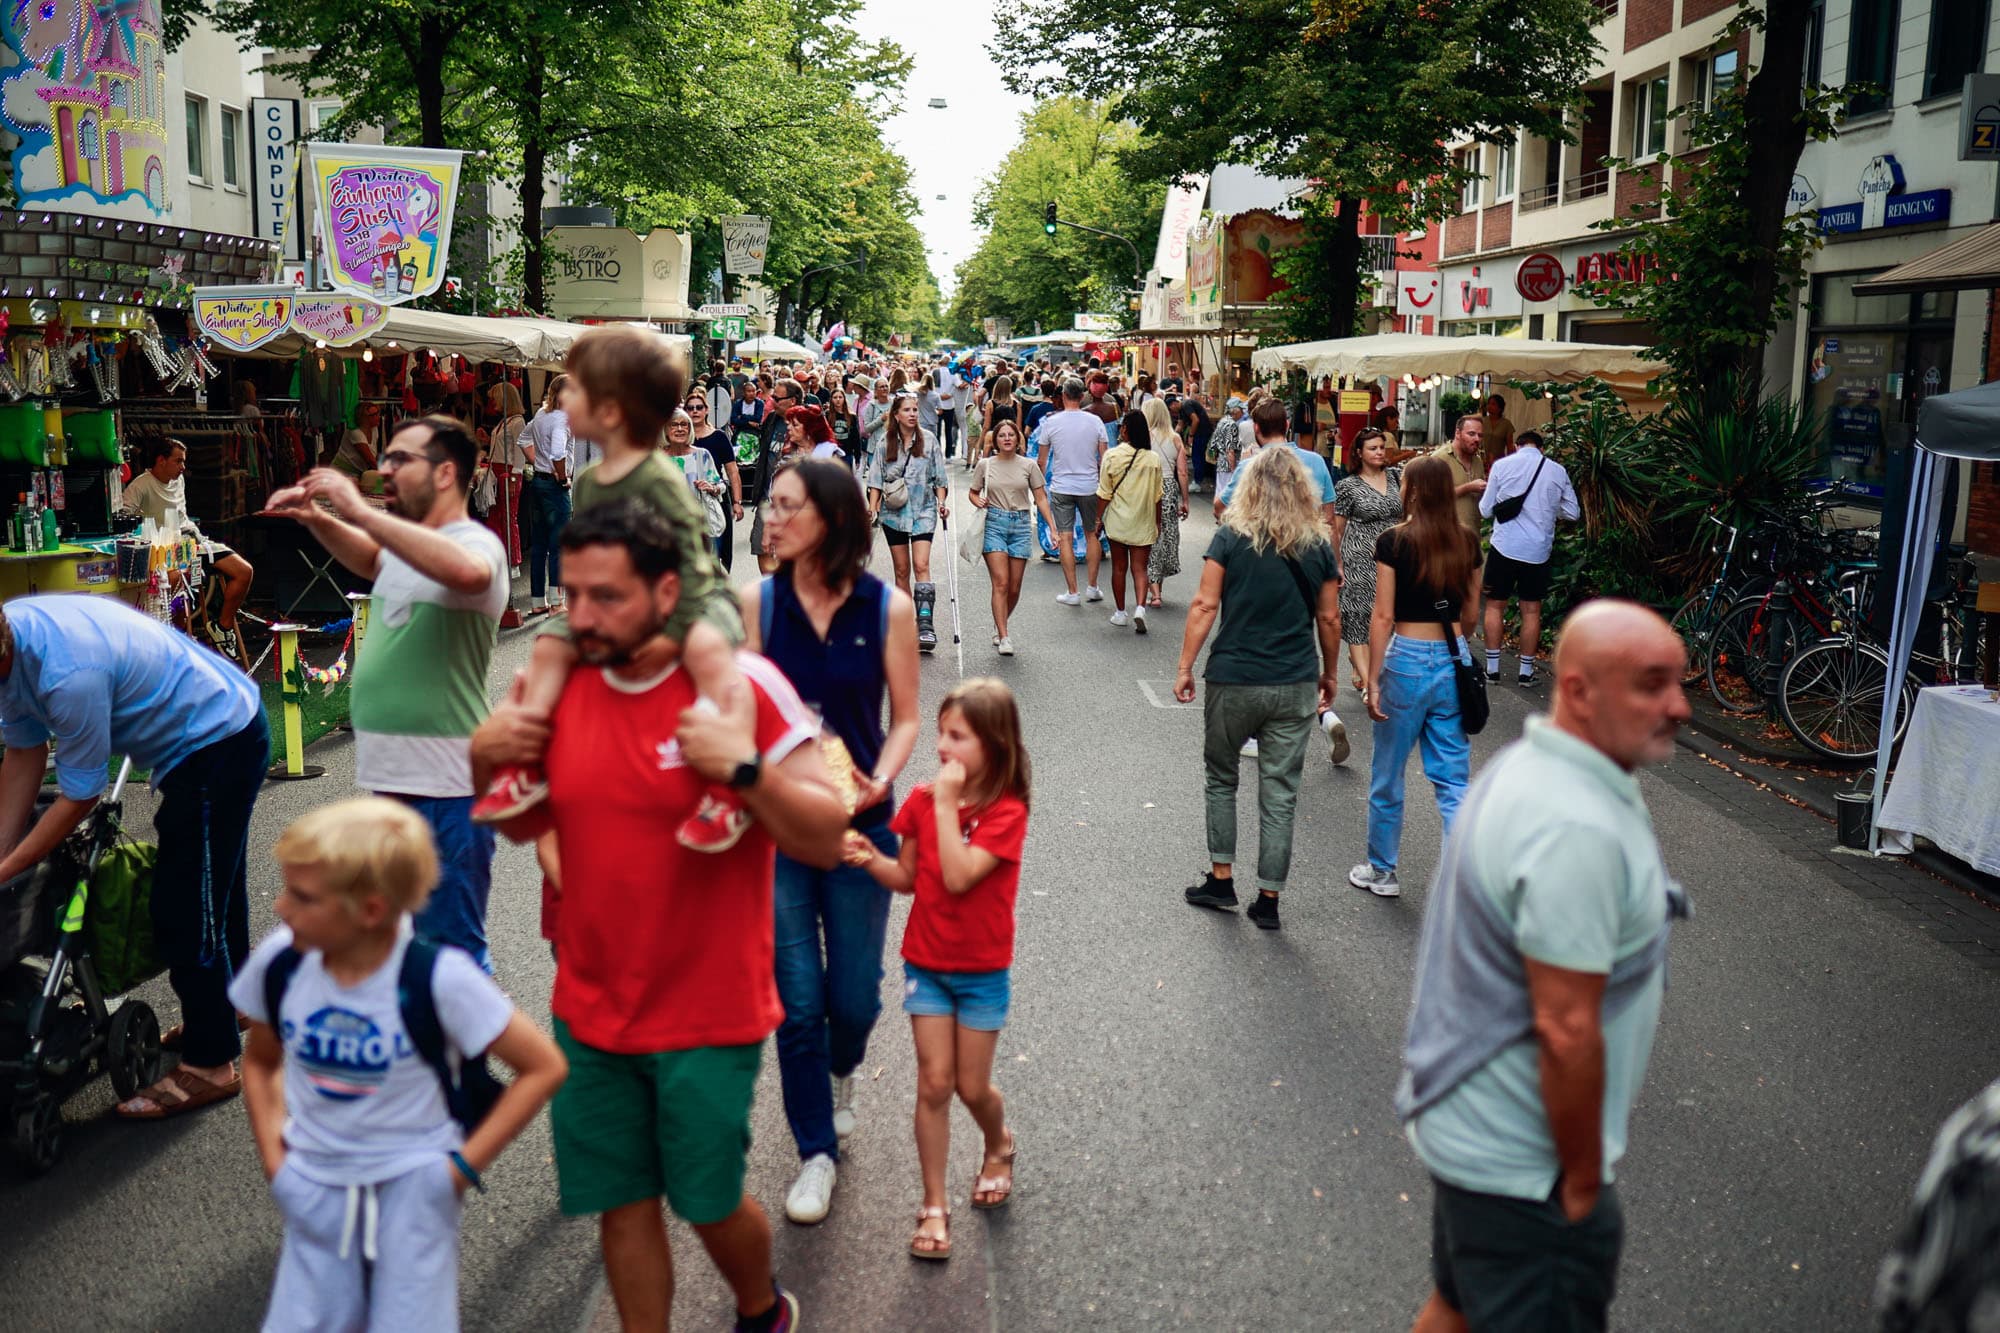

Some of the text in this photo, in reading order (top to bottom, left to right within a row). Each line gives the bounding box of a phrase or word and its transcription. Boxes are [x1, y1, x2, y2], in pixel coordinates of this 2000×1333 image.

[267, 107, 284, 244] COMPUTE
[331, 179, 404, 207] Einhorn
[1863, 180, 1892, 195] Panteha
[339, 202, 404, 233] Slush
[1822, 199, 1936, 228] PANTEHA REINIGUNG
[725, 227, 767, 256] Crêpes
[345, 241, 411, 271] Umdrehungen
[578, 245, 606, 259] Petit
[564, 260, 621, 278] BISTRO
[303, 310, 343, 330] Einhorn
[704, 306, 746, 314] TOILETTEN
[205, 312, 281, 330] Einhorn-Slush
[326, 323, 354, 340] Slush
